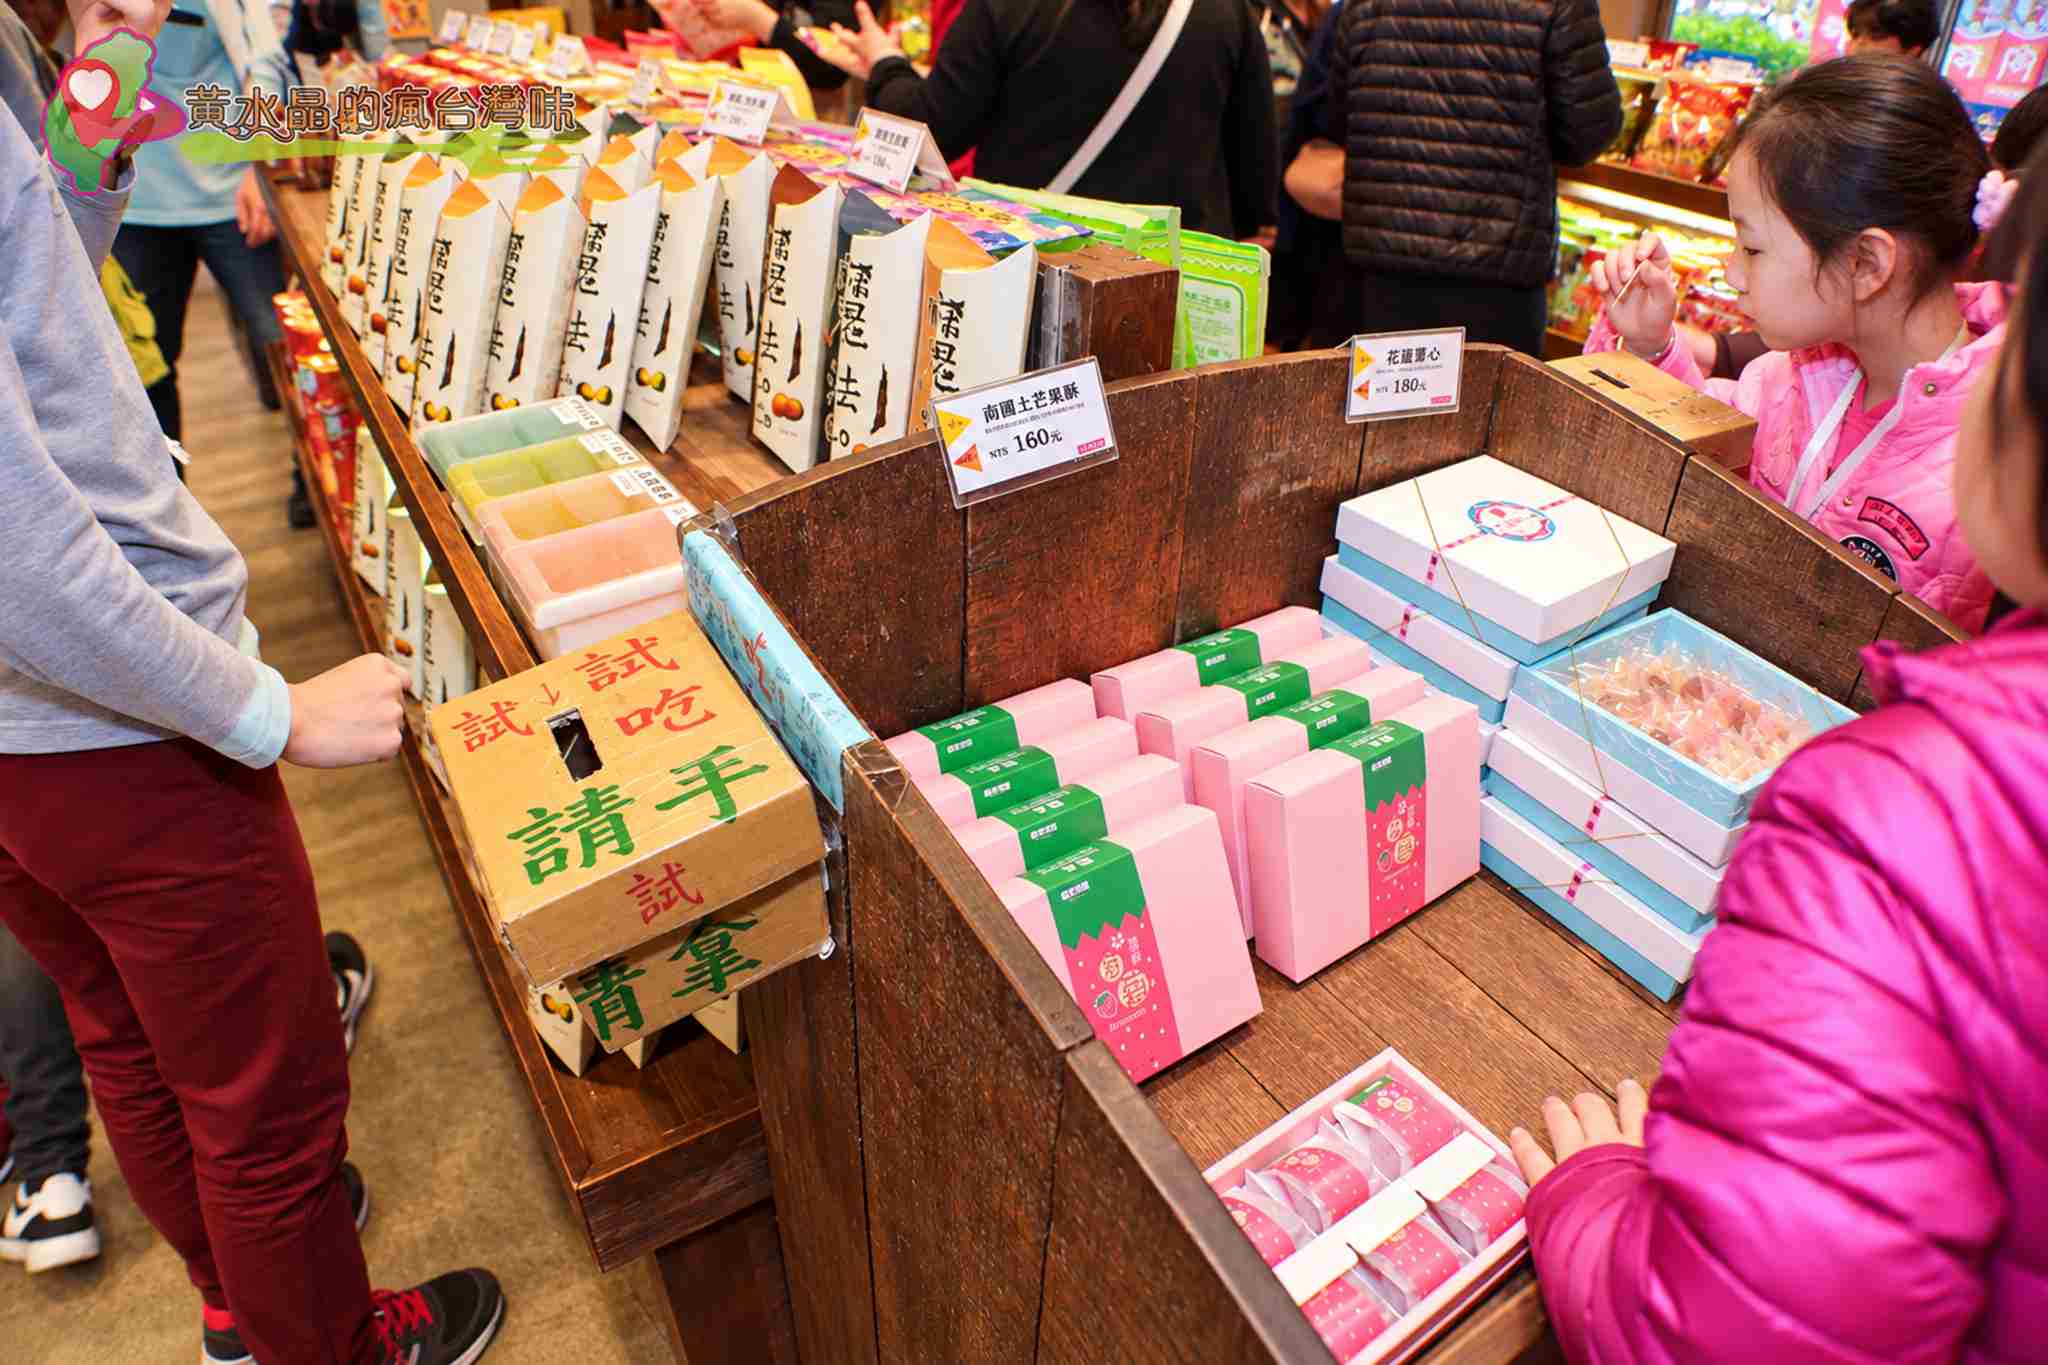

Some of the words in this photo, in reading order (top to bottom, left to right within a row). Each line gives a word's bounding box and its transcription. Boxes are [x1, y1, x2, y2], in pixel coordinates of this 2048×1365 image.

[983, 381, 1081, 425] 南國土芒果酥
[451, 700, 534, 753] 試
[625, 862, 704, 926] 試
